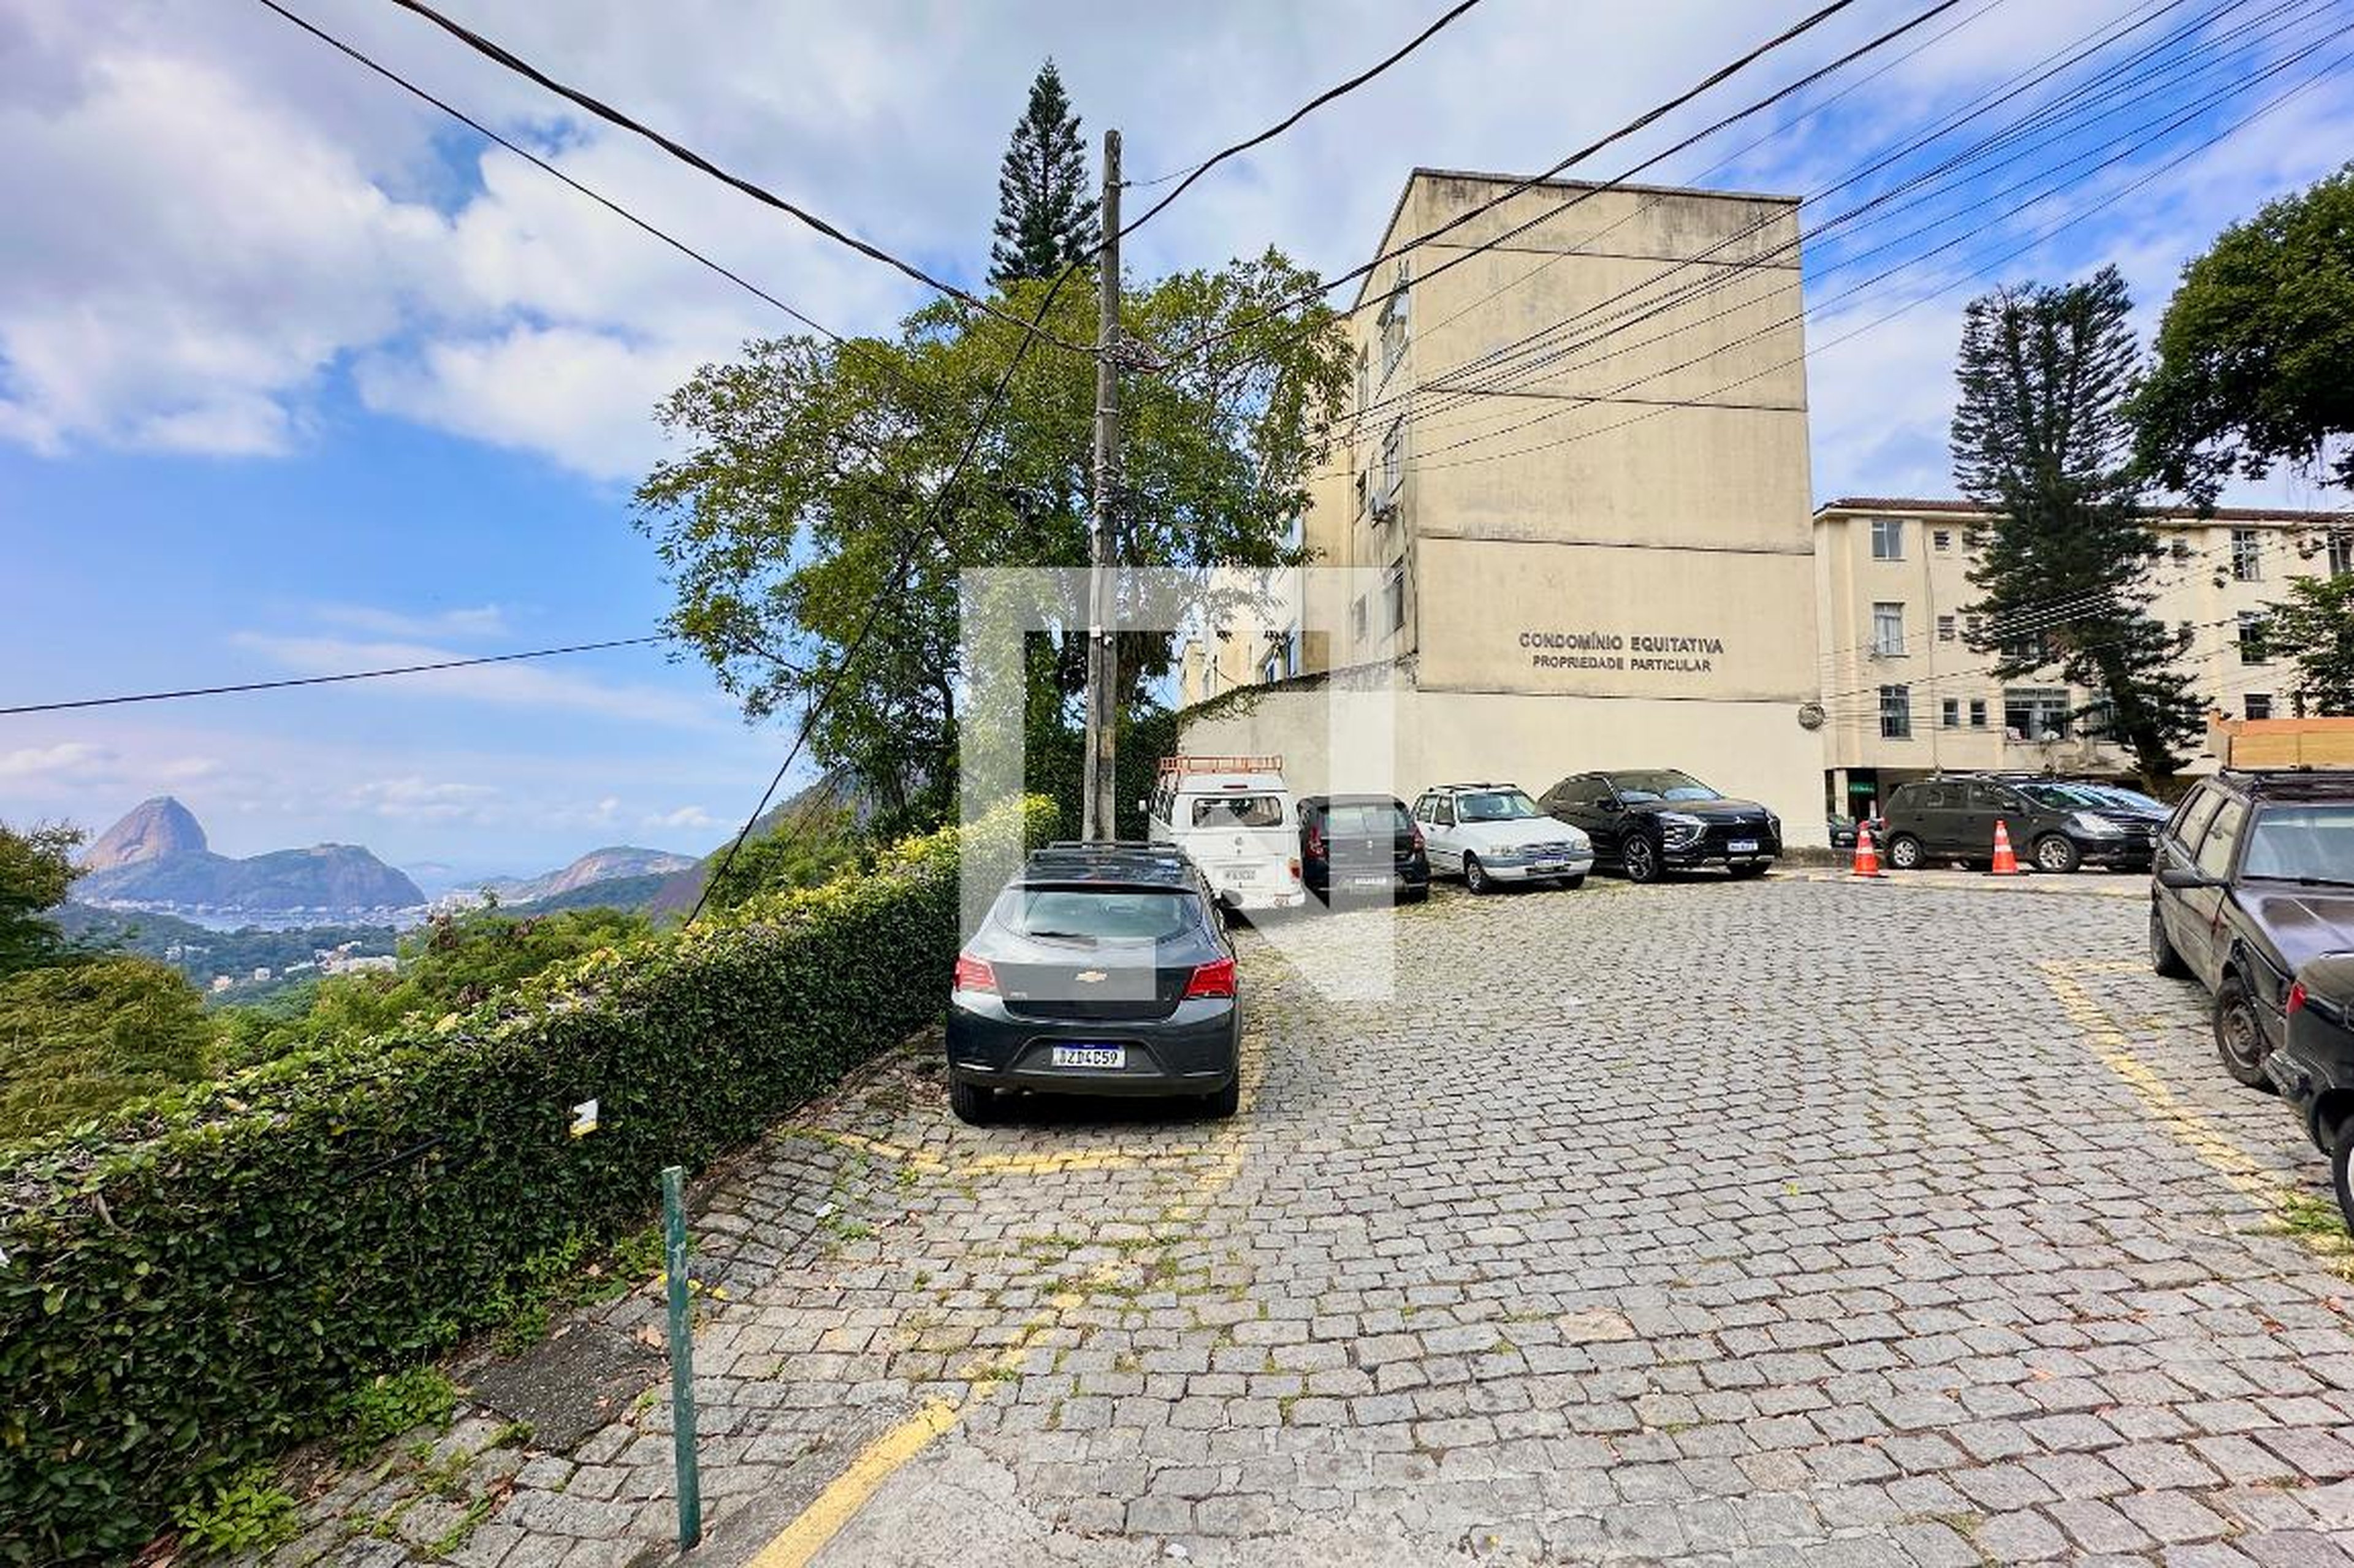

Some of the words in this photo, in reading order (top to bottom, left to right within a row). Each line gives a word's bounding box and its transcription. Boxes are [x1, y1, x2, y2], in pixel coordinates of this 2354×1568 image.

[1518, 631, 1623, 651] CONDOMÍNIO
[1630, 635, 1724, 654] EQUITATIVA
[1533, 655, 1625, 670] PROPRIEDADE
[1630, 658, 1712, 672] PARTICULAR
